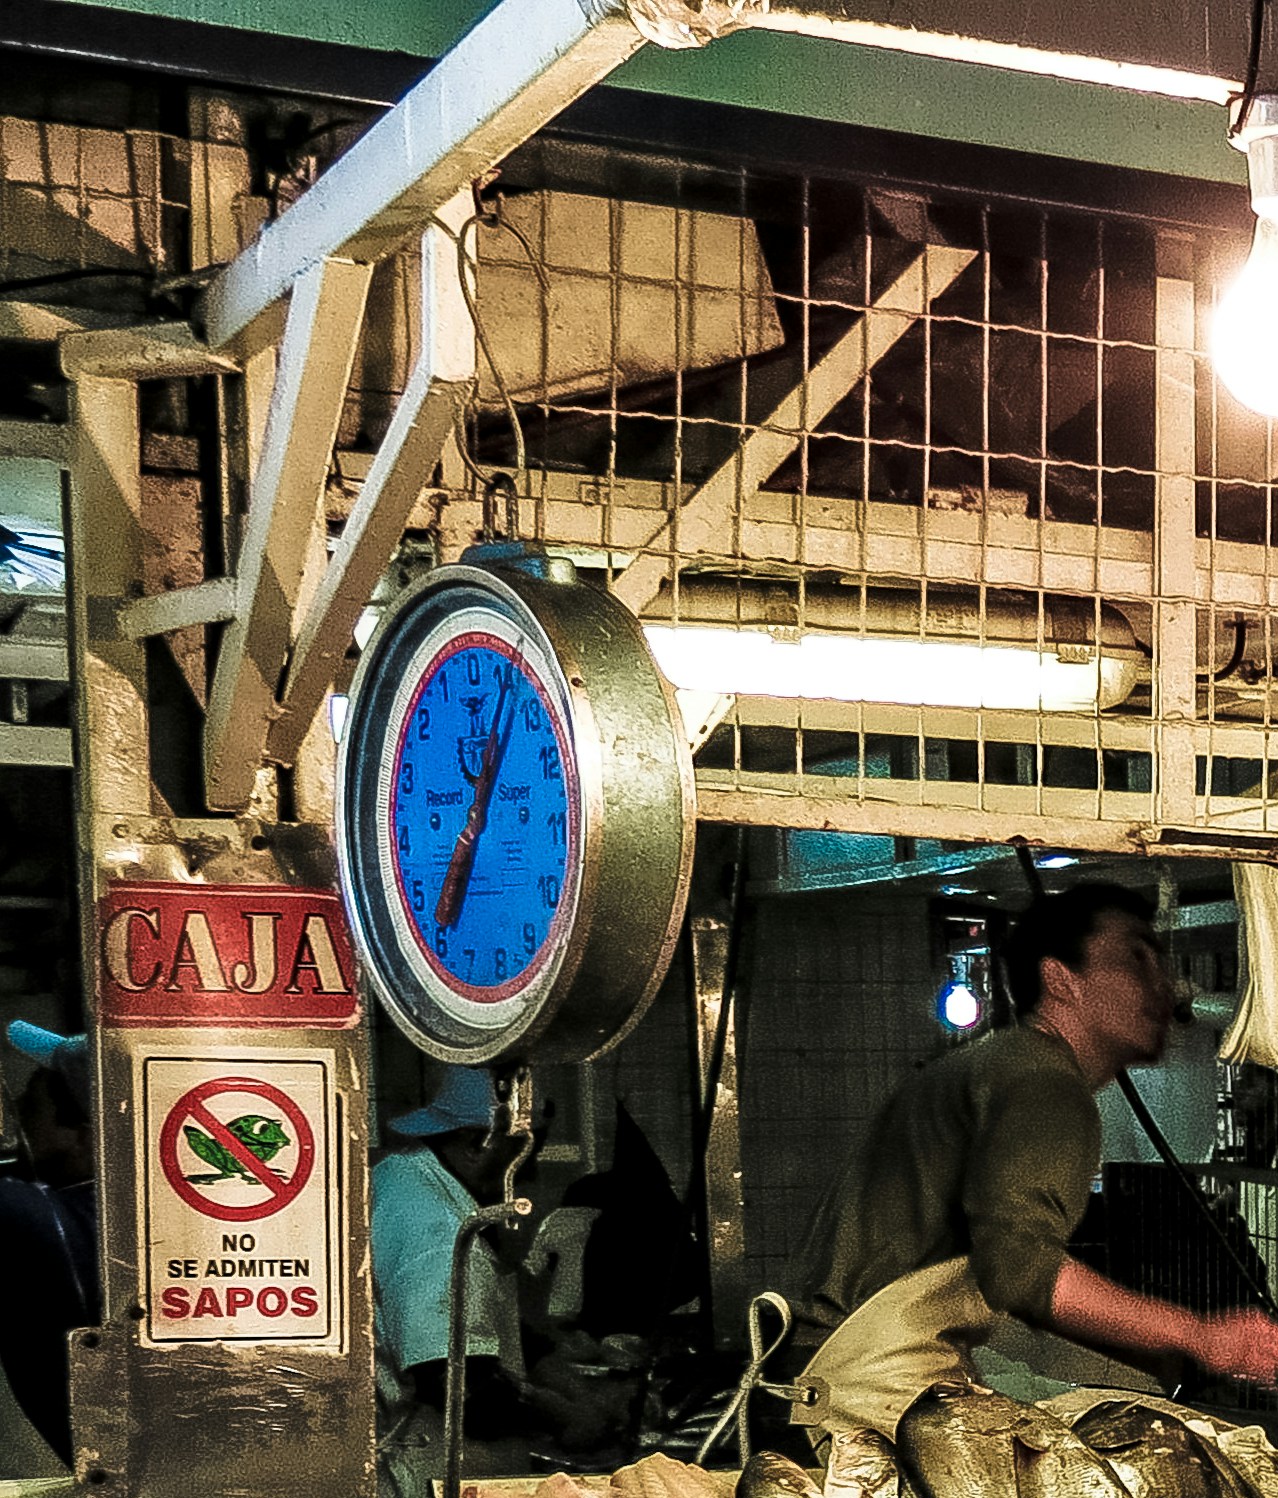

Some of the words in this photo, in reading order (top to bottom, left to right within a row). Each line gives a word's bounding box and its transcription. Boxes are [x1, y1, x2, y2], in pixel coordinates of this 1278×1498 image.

[426, 789, 463, 807] Record
[498, 784, 531, 804] Super
[102, 908, 350, 994] CAJA
[221, 1233, 256, 1253] NO
[168, 1259, 204, 1278] SE
[206, 1258, 311, 1278] ADMITEN
[160, 1286, 320, 1320] SAPOS
